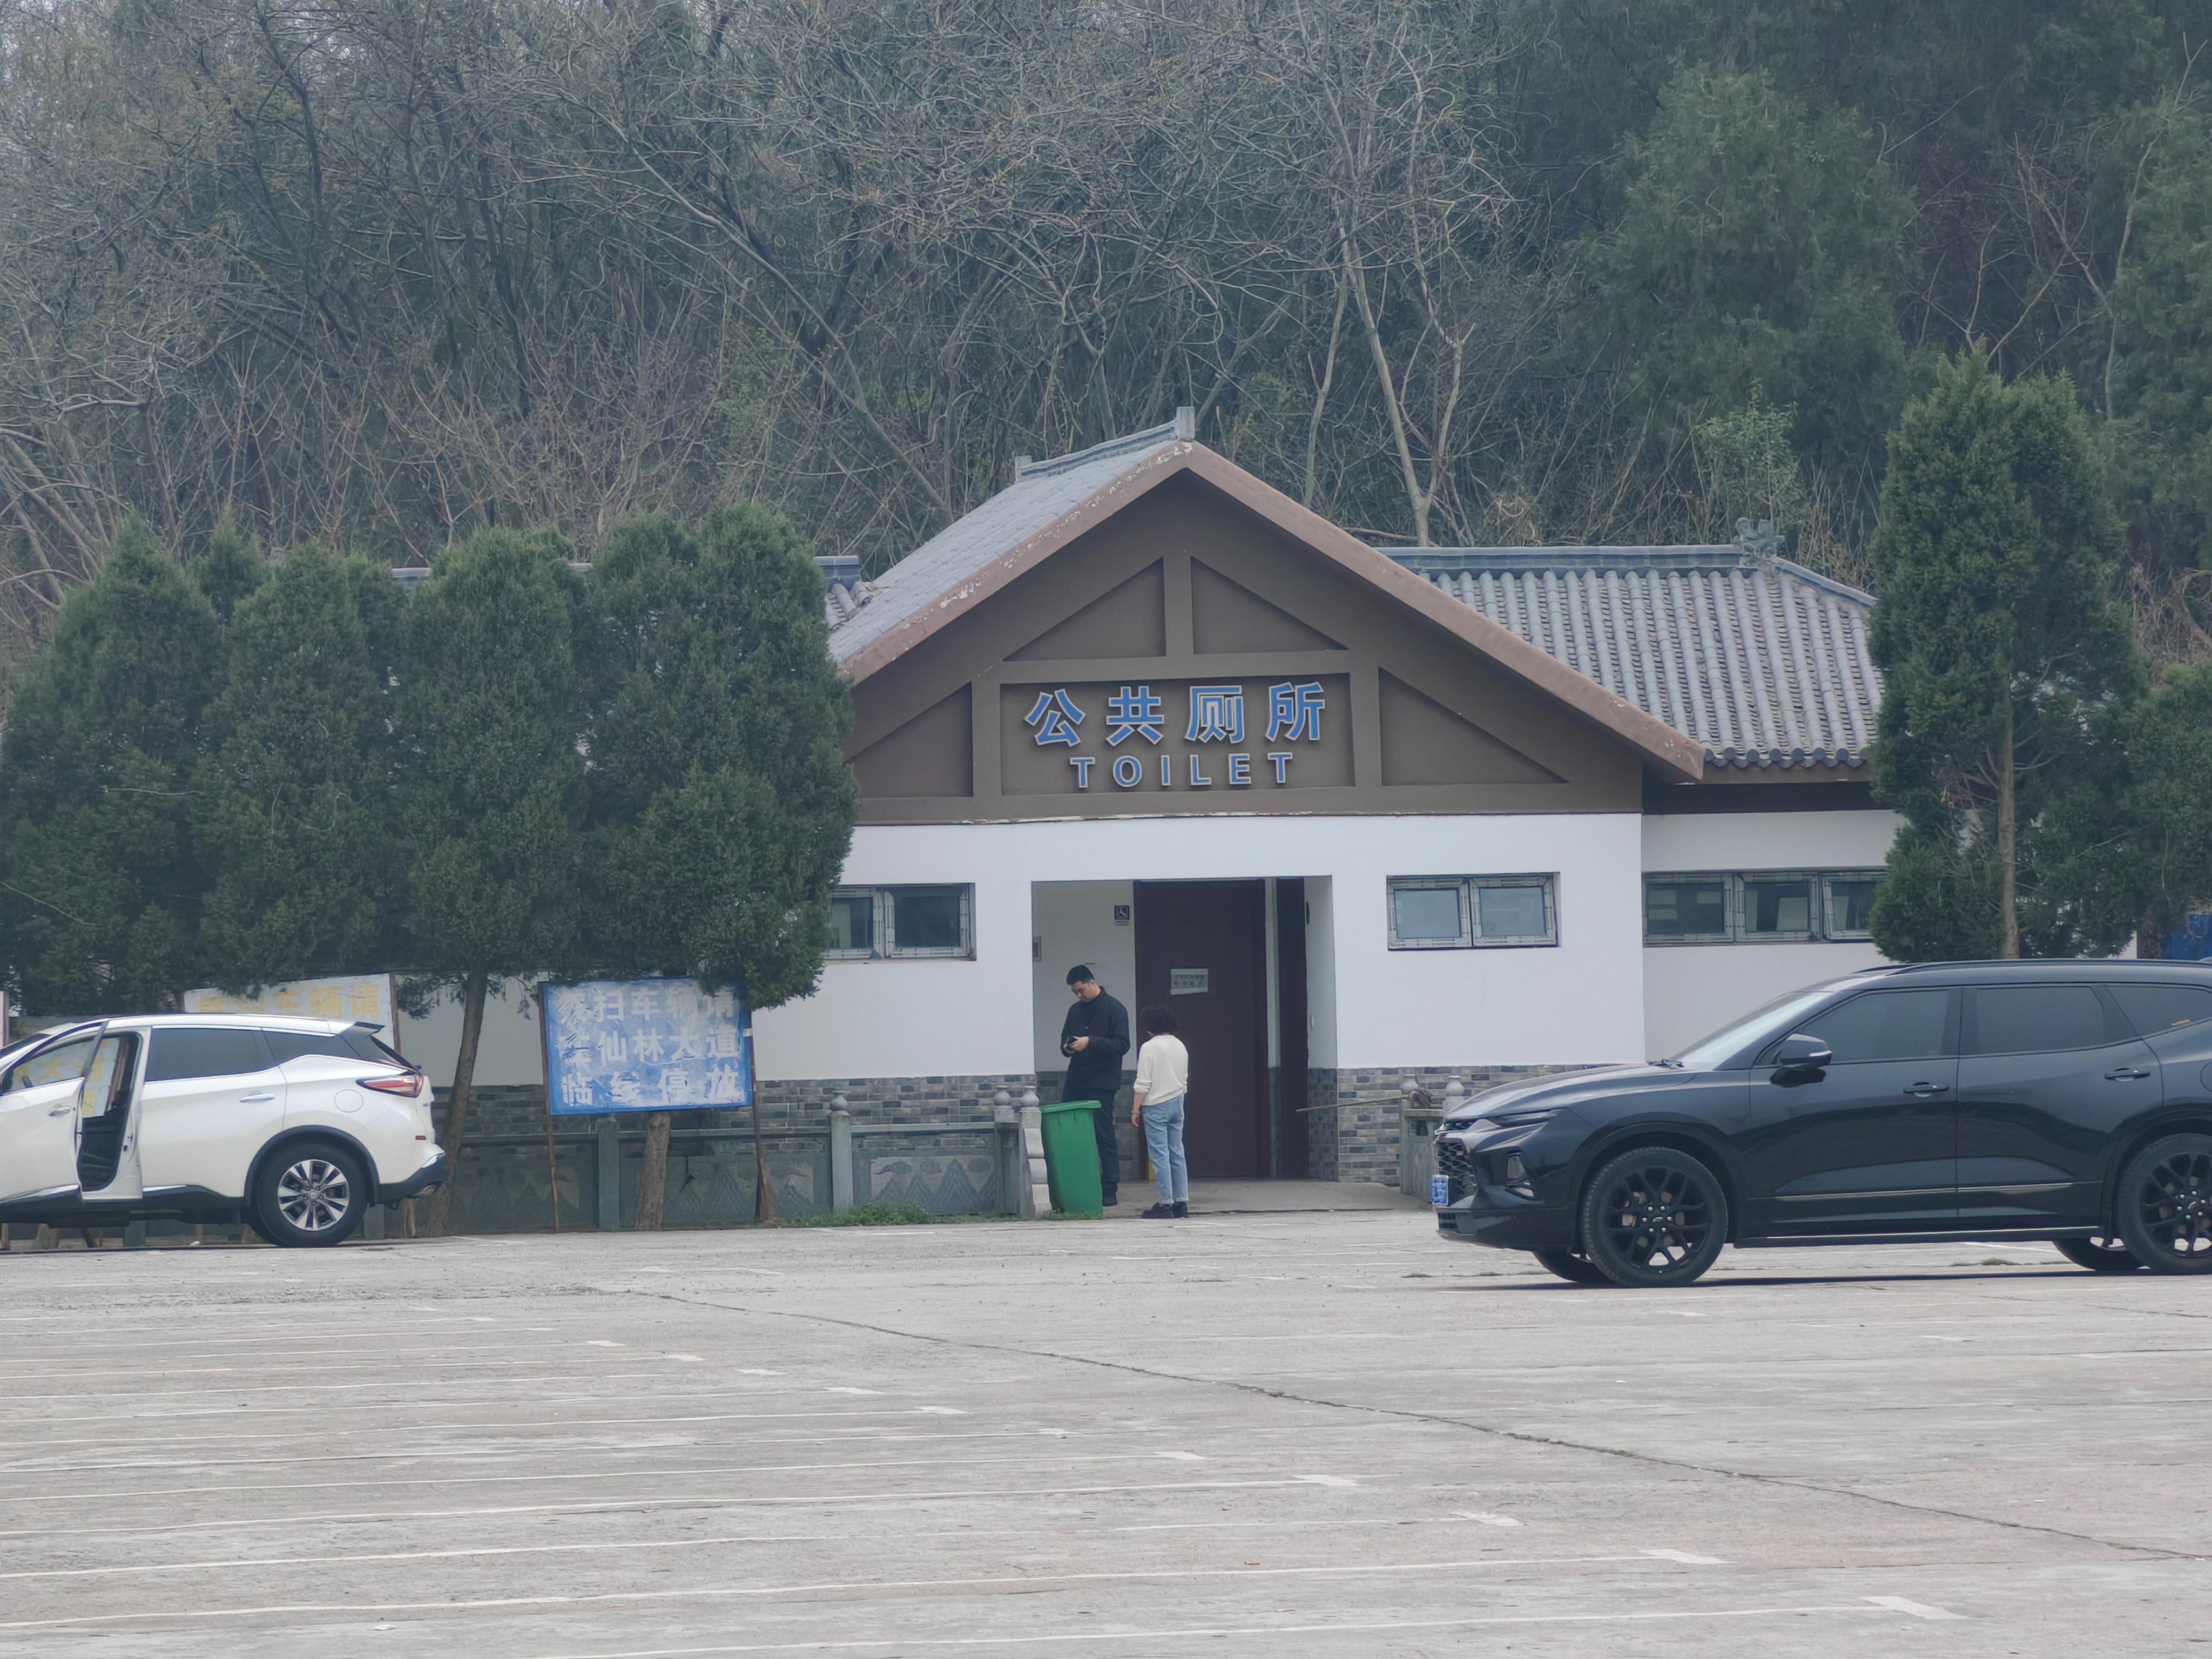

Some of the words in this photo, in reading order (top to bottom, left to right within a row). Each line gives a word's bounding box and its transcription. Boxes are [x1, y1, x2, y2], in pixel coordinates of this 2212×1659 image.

[1024, 682, 1325, 747] 公共厕所
[1069, 752, 1293, 788] TOILET
